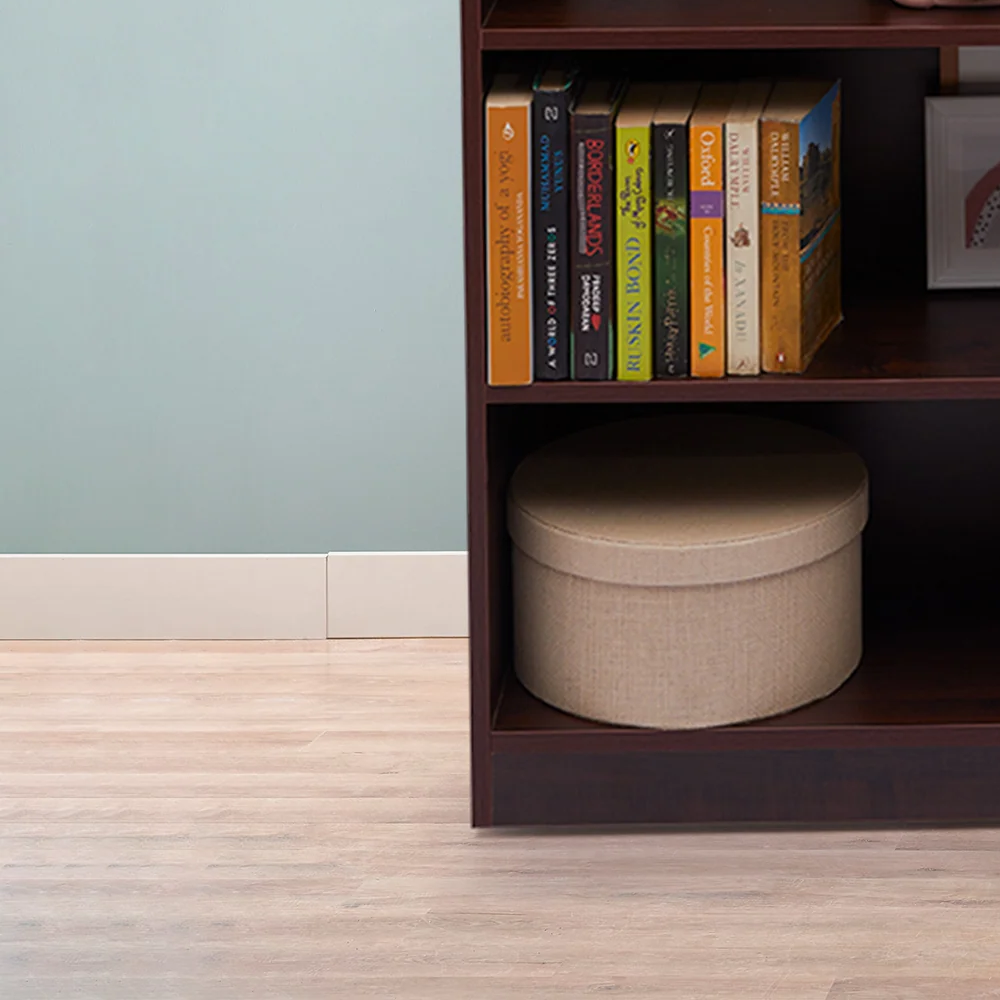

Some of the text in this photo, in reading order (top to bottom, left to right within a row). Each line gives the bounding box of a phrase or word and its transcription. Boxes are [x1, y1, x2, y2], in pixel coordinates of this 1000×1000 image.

[540, 134, 551, 211] MUHAMMAD
[553, 149, 564, 193] YUNUS
[700, 131, 716, 187] Oxford
[729, 132, 740, 209] DALRYMPLE
[742, 146, 751, 194] WILLIAM
[770, 131, 780, 197] DALRYMPLE
[781, 132, 790, 182] WILLIAM
[586, 138, 605, 257] BORDERLANDS
[620, 200, 632, 216] The
[631, 218, 647, 230] of
[494, 150, 516, 343] autobiography of a yogi
[703, 225, 715, 273] Countries
[546, 226, 557, 369] A WORLD OF THREE ZEROS
[580, 274, 591, 332] DAMODARAN
[591, 274, 602, 313] PRADEEP
[624, 237, 642, 373] RUSKIN BOND
[703, 276, 715, 288] of
[703, 288, 715, 303] the
[771, 251, 781, 308] MOUNTAIN
[703, 304, 715, 335] World
[735, 276, 747, 342] XANADU
